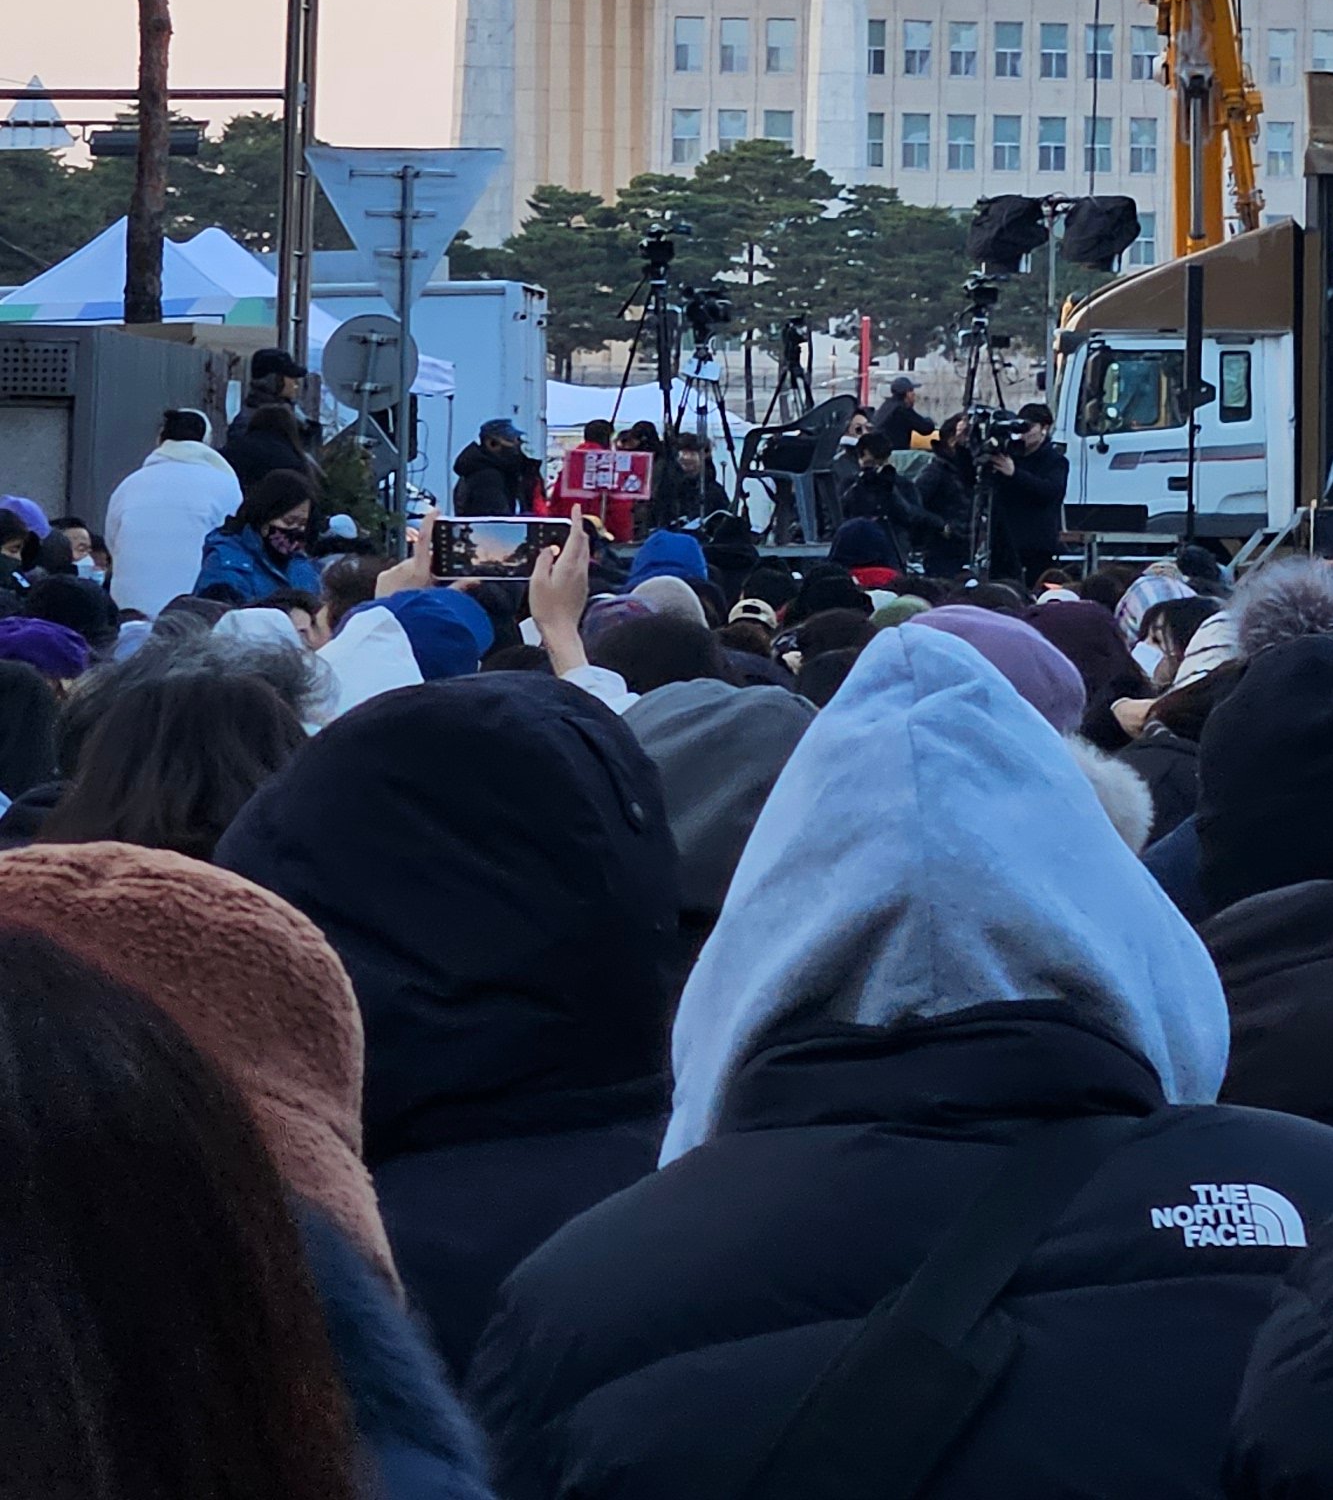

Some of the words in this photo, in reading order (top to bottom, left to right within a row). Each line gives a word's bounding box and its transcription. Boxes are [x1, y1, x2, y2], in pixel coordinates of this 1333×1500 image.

[1190, 1183, 1250, 1204] THE
[1150, 1203, 1253, 1229] NORTH
[1184, 1223, 1258, 1248] FACE
